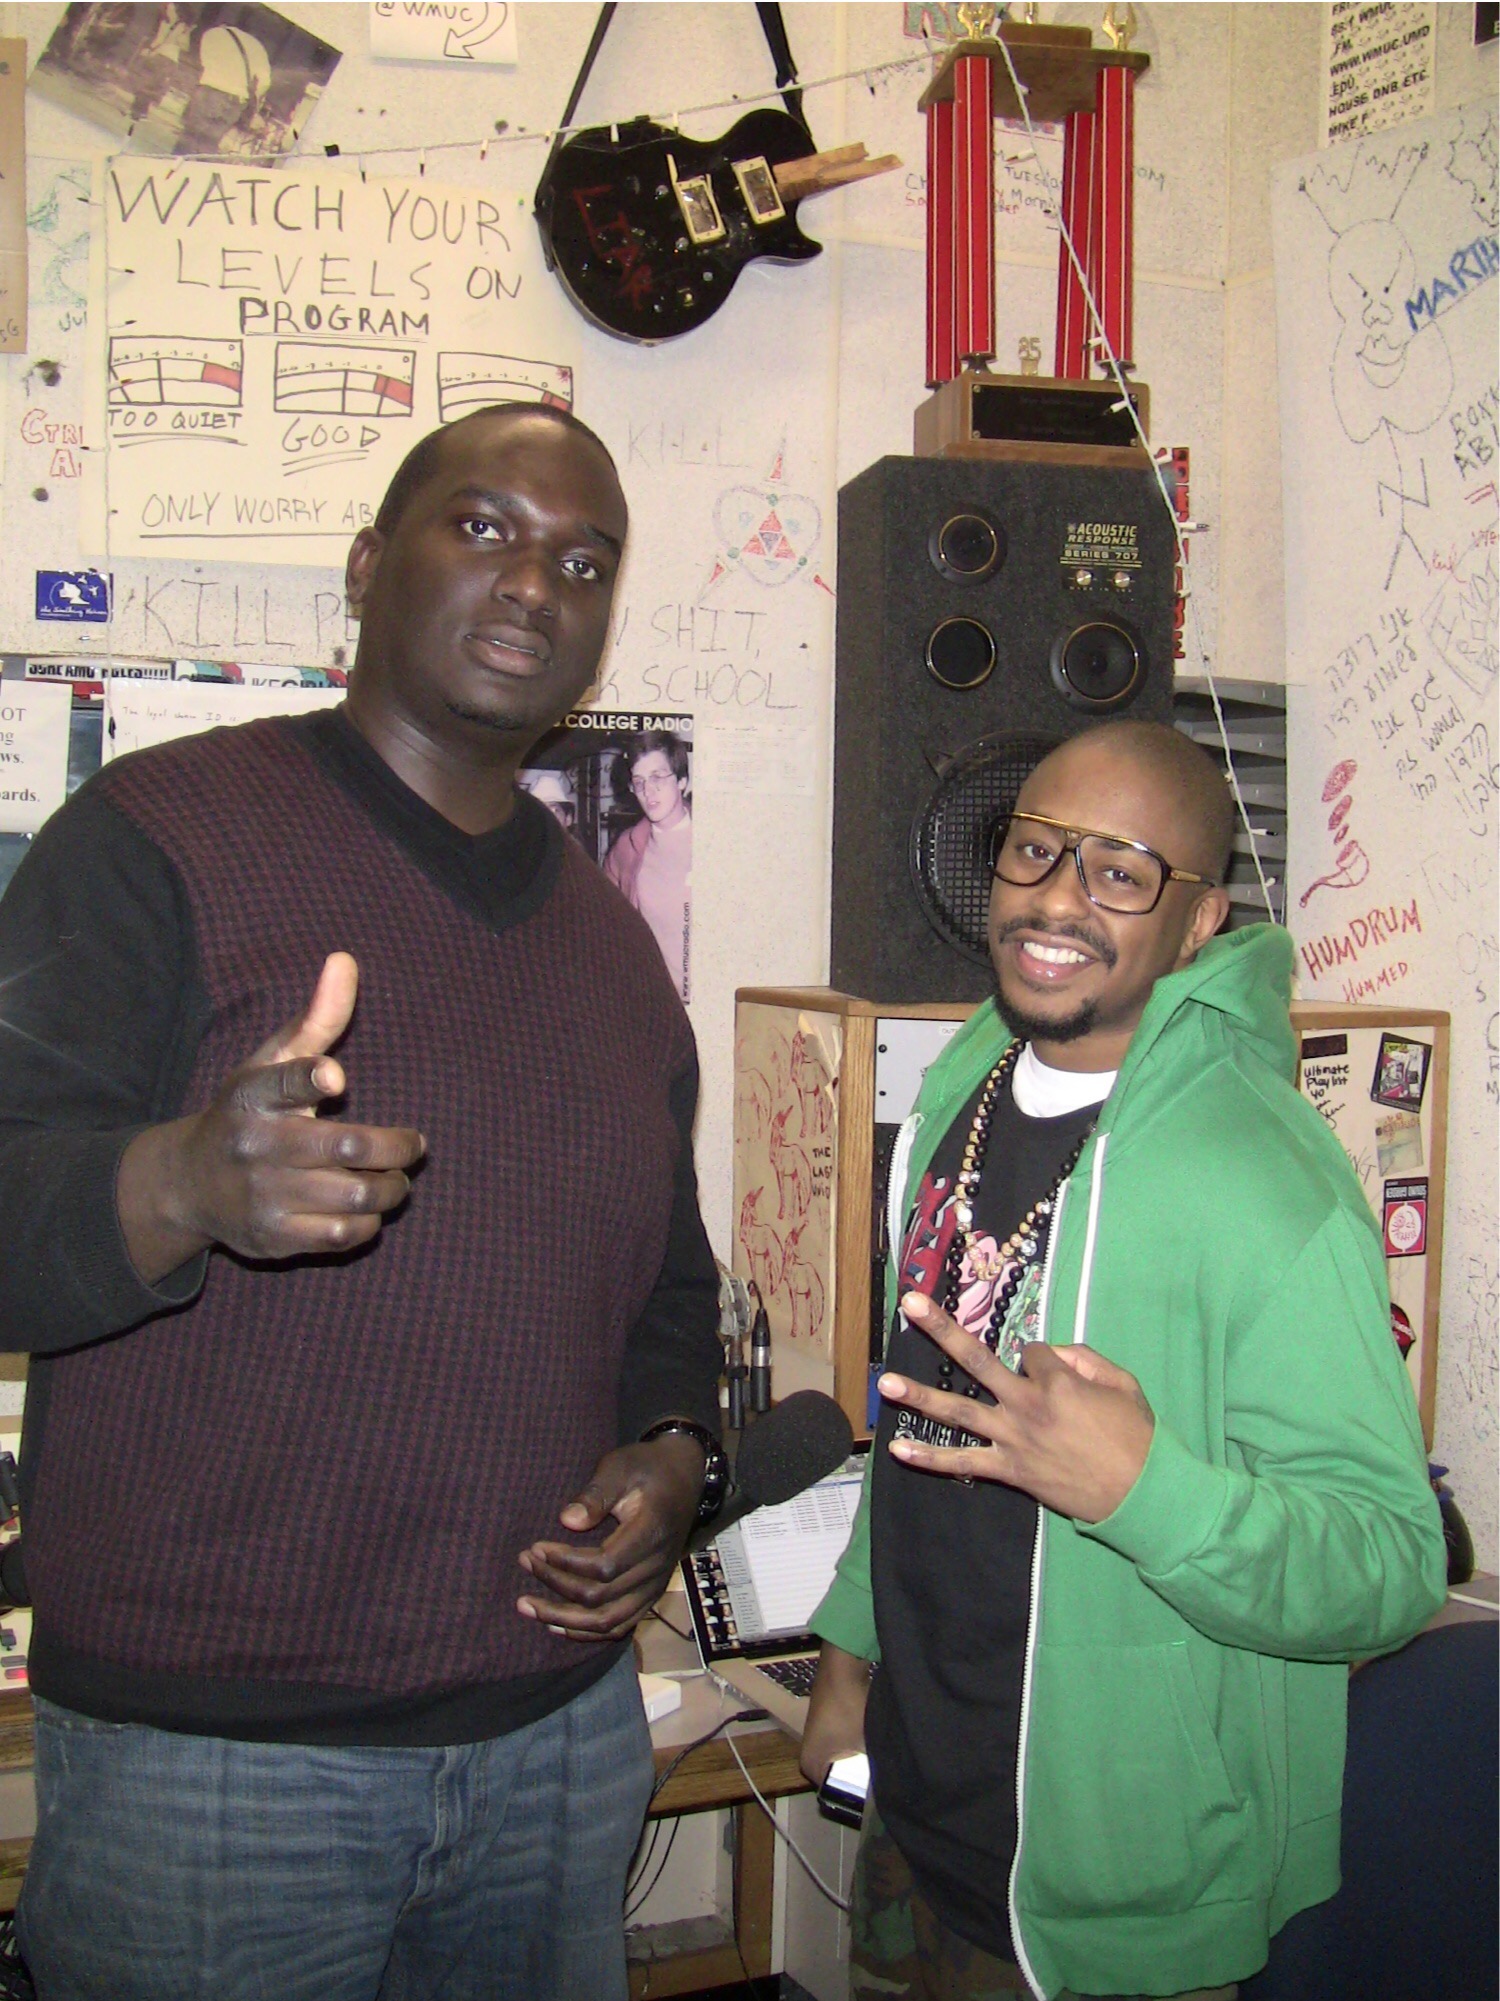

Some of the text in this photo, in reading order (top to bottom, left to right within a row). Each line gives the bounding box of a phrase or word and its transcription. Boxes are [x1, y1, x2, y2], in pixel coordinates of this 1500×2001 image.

[1328, 92, 1369, 118] HOUSE
[110, 170, 345, 232] WATCH
[382, 187, 512, 252] YOUR
[176, 238, 522, 300] LEVELS ON
[239, 296, 431, 337] PROGRAM
[107, 408, 243, 429] TOO QUIET
[282, 416, 381, 453] GOOD
[141, 491, 221, 528] ONLY
[234, 494, 328, 524] WORRY
[1068, 535, 1136, 546] RESPONSE
[1077, 523, 1138, 538] ACOUSTIC
[1065, 549, 1138, 560] SERIES 707
[639, 663, 803, 710] SCHOOL
[565, 714, 694, 732] COLLEGE RADIO
[1300, 898, 1422, 982] HUMDRUM
[1341, 961, 1408, 1005] HUMMED
[1304, 1063, 1350, 1078] Ultimate
[812, 1147, 832, 1158] THE
